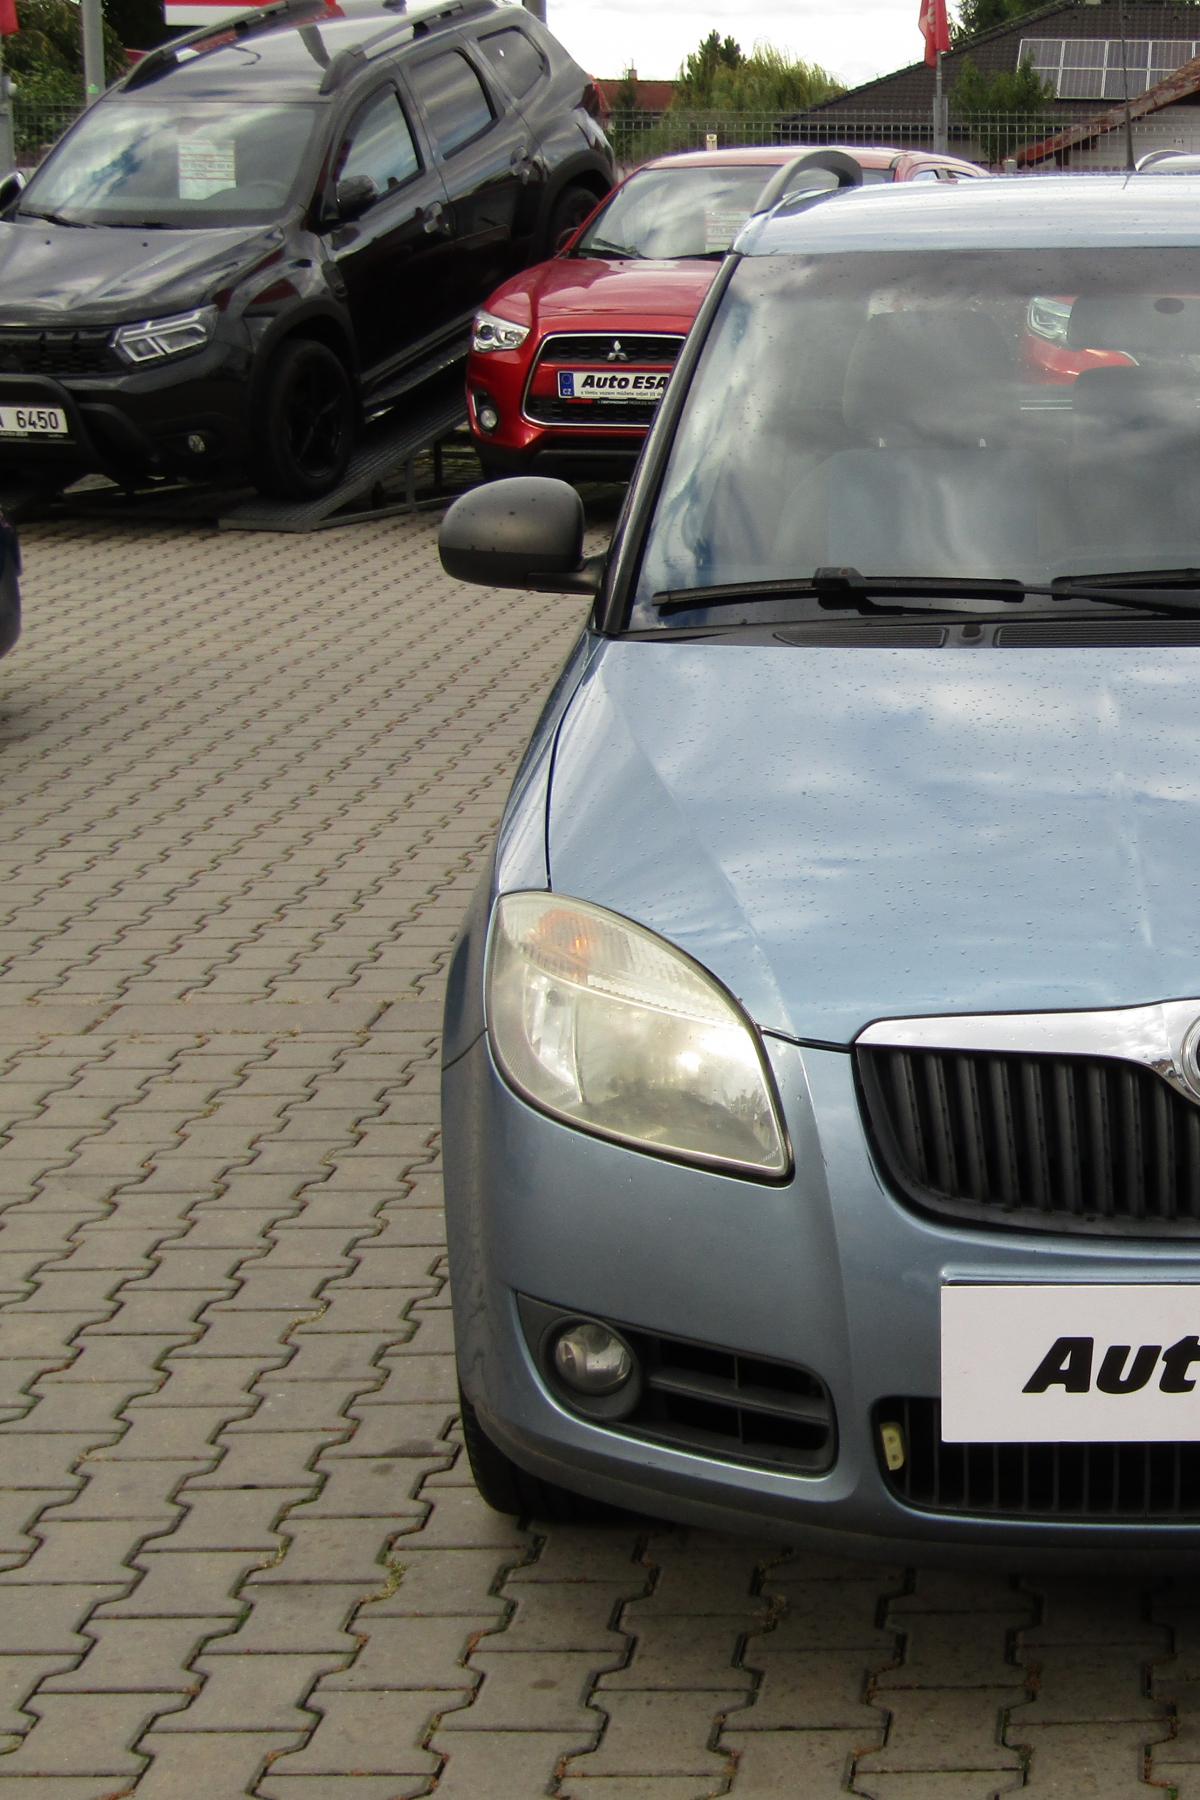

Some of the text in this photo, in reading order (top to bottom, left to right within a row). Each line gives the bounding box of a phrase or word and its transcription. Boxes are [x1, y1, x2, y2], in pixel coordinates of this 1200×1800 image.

[581, 374, 670, 389] Auto ESA
[16, 410, 59, 430] 6450
